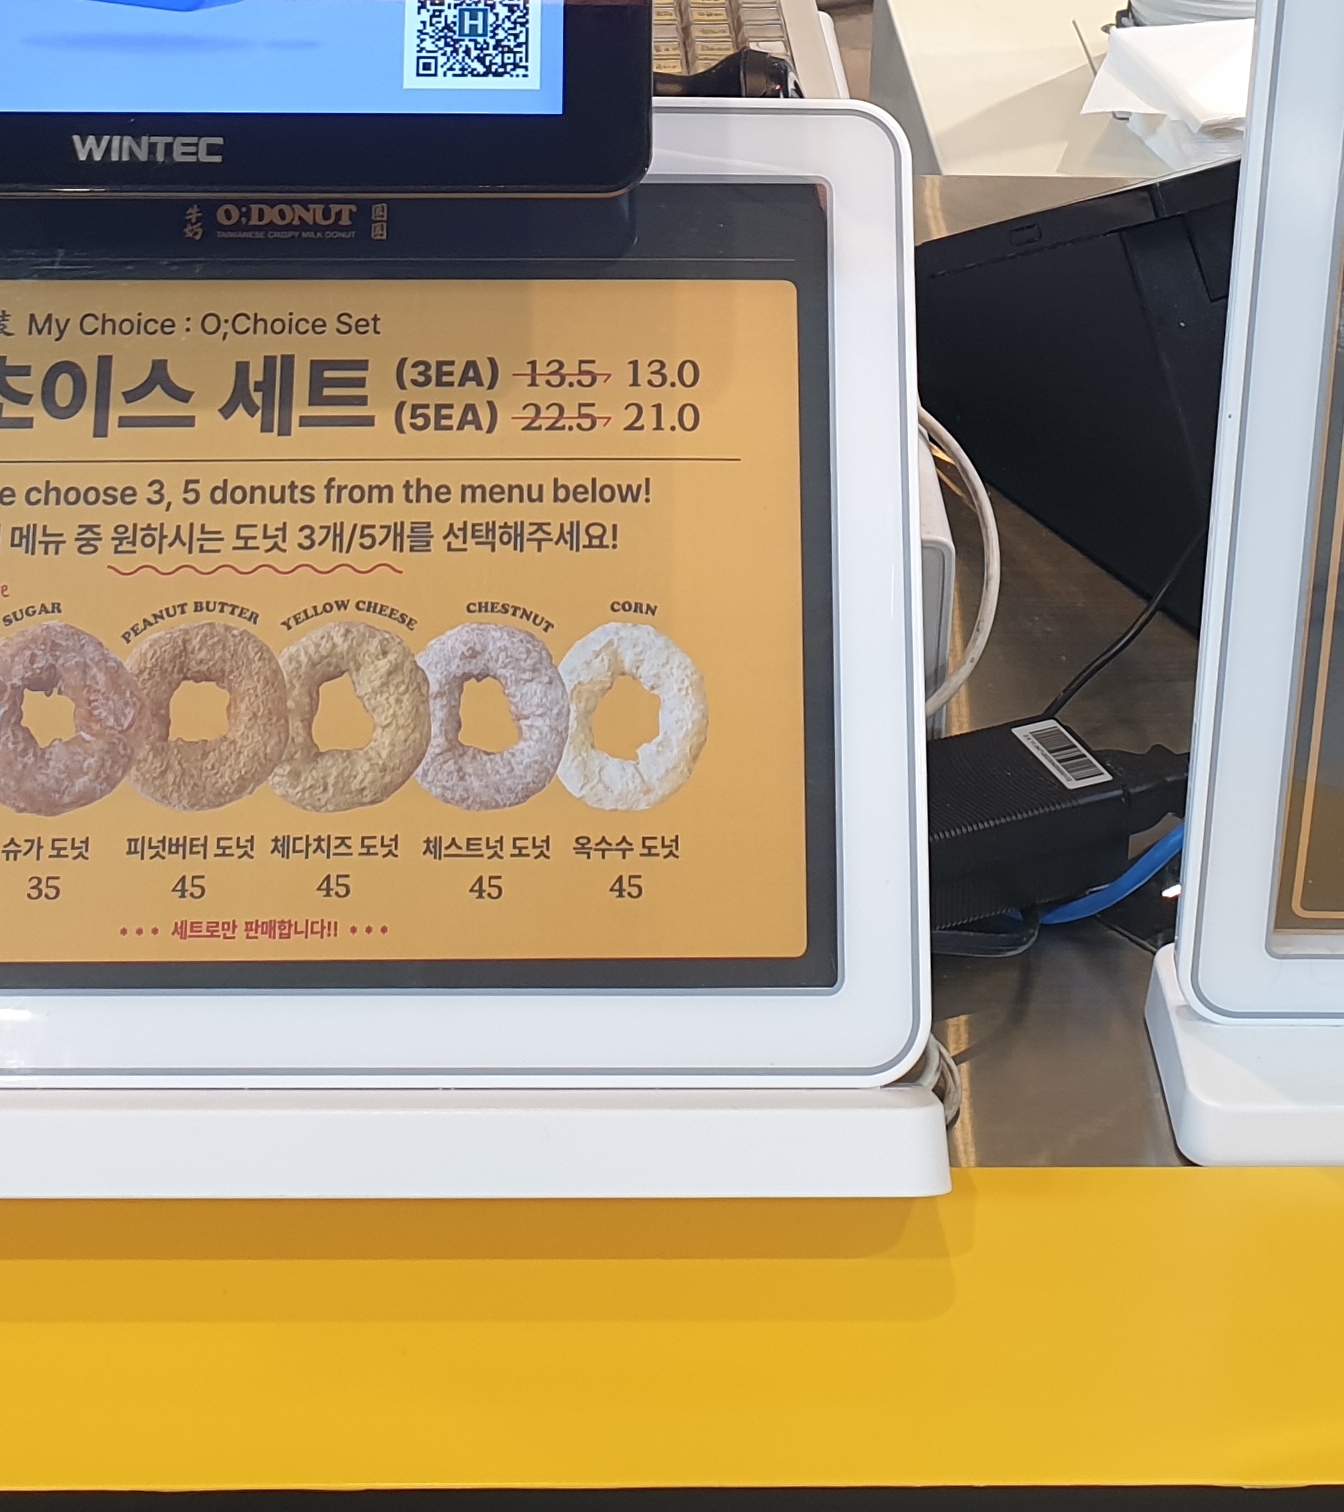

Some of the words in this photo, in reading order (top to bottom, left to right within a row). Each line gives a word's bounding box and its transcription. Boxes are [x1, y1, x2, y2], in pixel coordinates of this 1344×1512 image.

[72, 133, 225, 163] WINTEC
[216, 203, 358, 226] O;DONUT
[28, 313, 71, 342] My
[79, 311, 176, 336] Choice
[200, 311, 328, 342] O;Choice
[336, 312, 381, 336] Set
[395, 356, 501, 391] (3EA)
[525, 358, 599, 389] 13.5
[626, 358, 701, 389] 13.0
[218, 353, 377, 438] 세트
[393, 400, 499, 435] (5EA)
[520, 401, 598, 433] 22.5
[622, 401, 701, 433] 21.0
[23, 479, 138, 507] choose
[145, 478, 173, 513] 3,
[181, 478, 201, 506] 5
[209, 478, 316, 505] donuts
[323, 477, 395, 504] from
[401, 477, 453, 504] the
[460, 480, 545, 504] menu
[552, 476, 653, 504] below!
[10, 522, 67, 557] 메뉴
[74, 523, 103, 555] 중
[110, 522, 225, 556] 원하시는
[231, 521, 288, 555] 도넛
[296, 520, 435, 555] 3개/5개를
[442, 519, 619, 554] 선택해주세요!
[1, 601, 63, 628] SUGAR
[279, 598, 351, 632] YELLOW
[354, 599, 419, 631] CHEESE
[465, 600, 555, 634] CHESTNUT
[609, 600, 659, 617] CORN
[120, 604, 189, 645] PEANUT
[192, 600, 261, 626] BUTTER
[0, 836, 44, 861] 슈가
[47, 835, 91, 861] 도넛
[125, 834, 209, 861] 피넛버터
[213, 834, 256, 860] 도넛
[269, 834, 354, 860] 체다치즈
[358, 833, 400, 859] 도넛
[422, 835, 505, 861] 체스트넛
[509, 834, 552, 860] 도넛
[572, 834, 635, 861] 옥수수
[639, 834, 681, 860] 도넛
[26, 875, 62, 901] 35
[170, 874, 207, 900] 45
[315, 873, 352, 900] 45
[468, 874, 504, 901] 45
[608, 873, 644, 900] 45
[171, 919, 238, 940] 세트로만
[243, 918, 339, 940] 판매합니다!!
